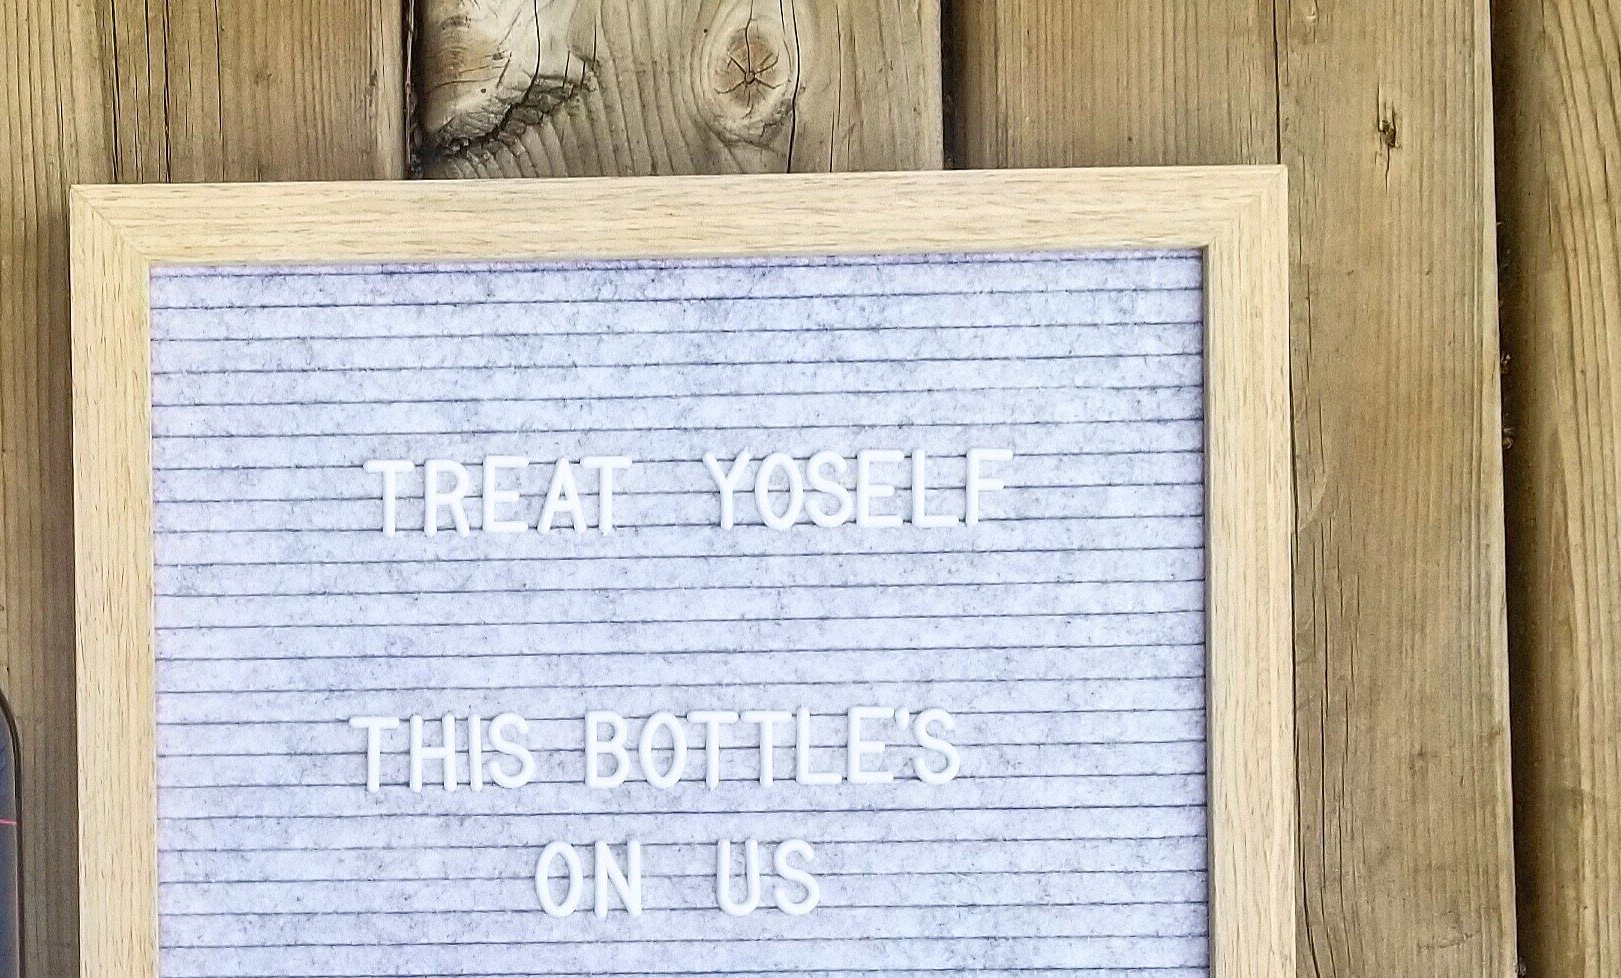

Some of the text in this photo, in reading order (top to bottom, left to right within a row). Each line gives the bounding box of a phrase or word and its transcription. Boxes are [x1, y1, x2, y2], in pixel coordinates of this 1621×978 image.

[363, 448, 1013, 537] TREAT YOSELF
[349, 706, 962, 793] THIS BOTTLE'S
[535, 839, 821, 918] ON US
